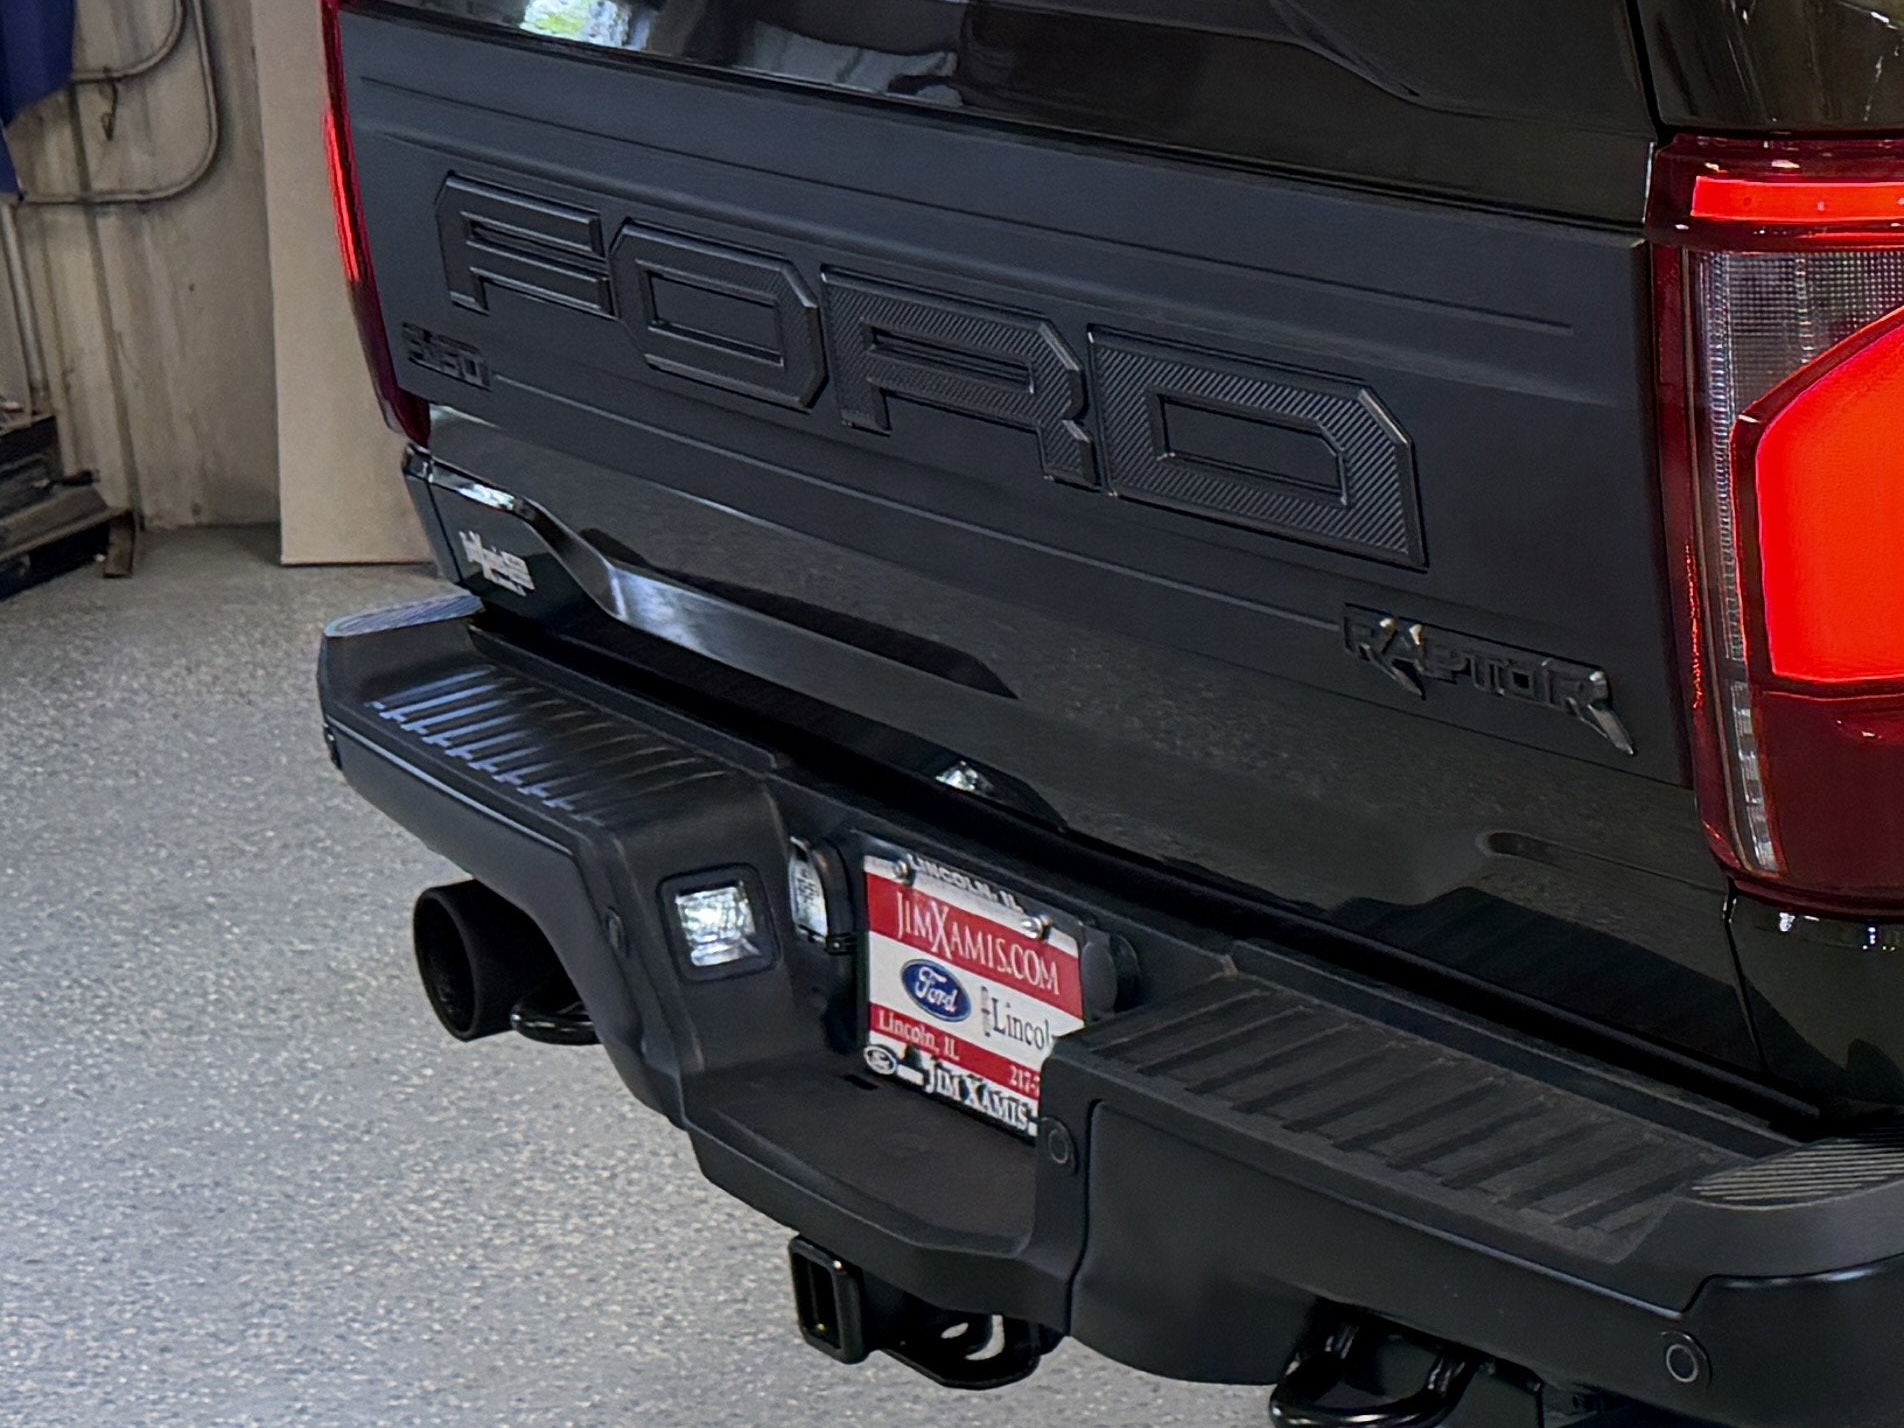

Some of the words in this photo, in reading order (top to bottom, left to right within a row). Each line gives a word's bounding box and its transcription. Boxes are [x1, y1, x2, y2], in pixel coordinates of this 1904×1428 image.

[434, 169, 1430, 569] FORD
[1344, 603, 1637, 756] RAPTOR
[897, 891, 1060, 995] JIMXAMIS.COM
[915, 966, 958, 1013] Ford
